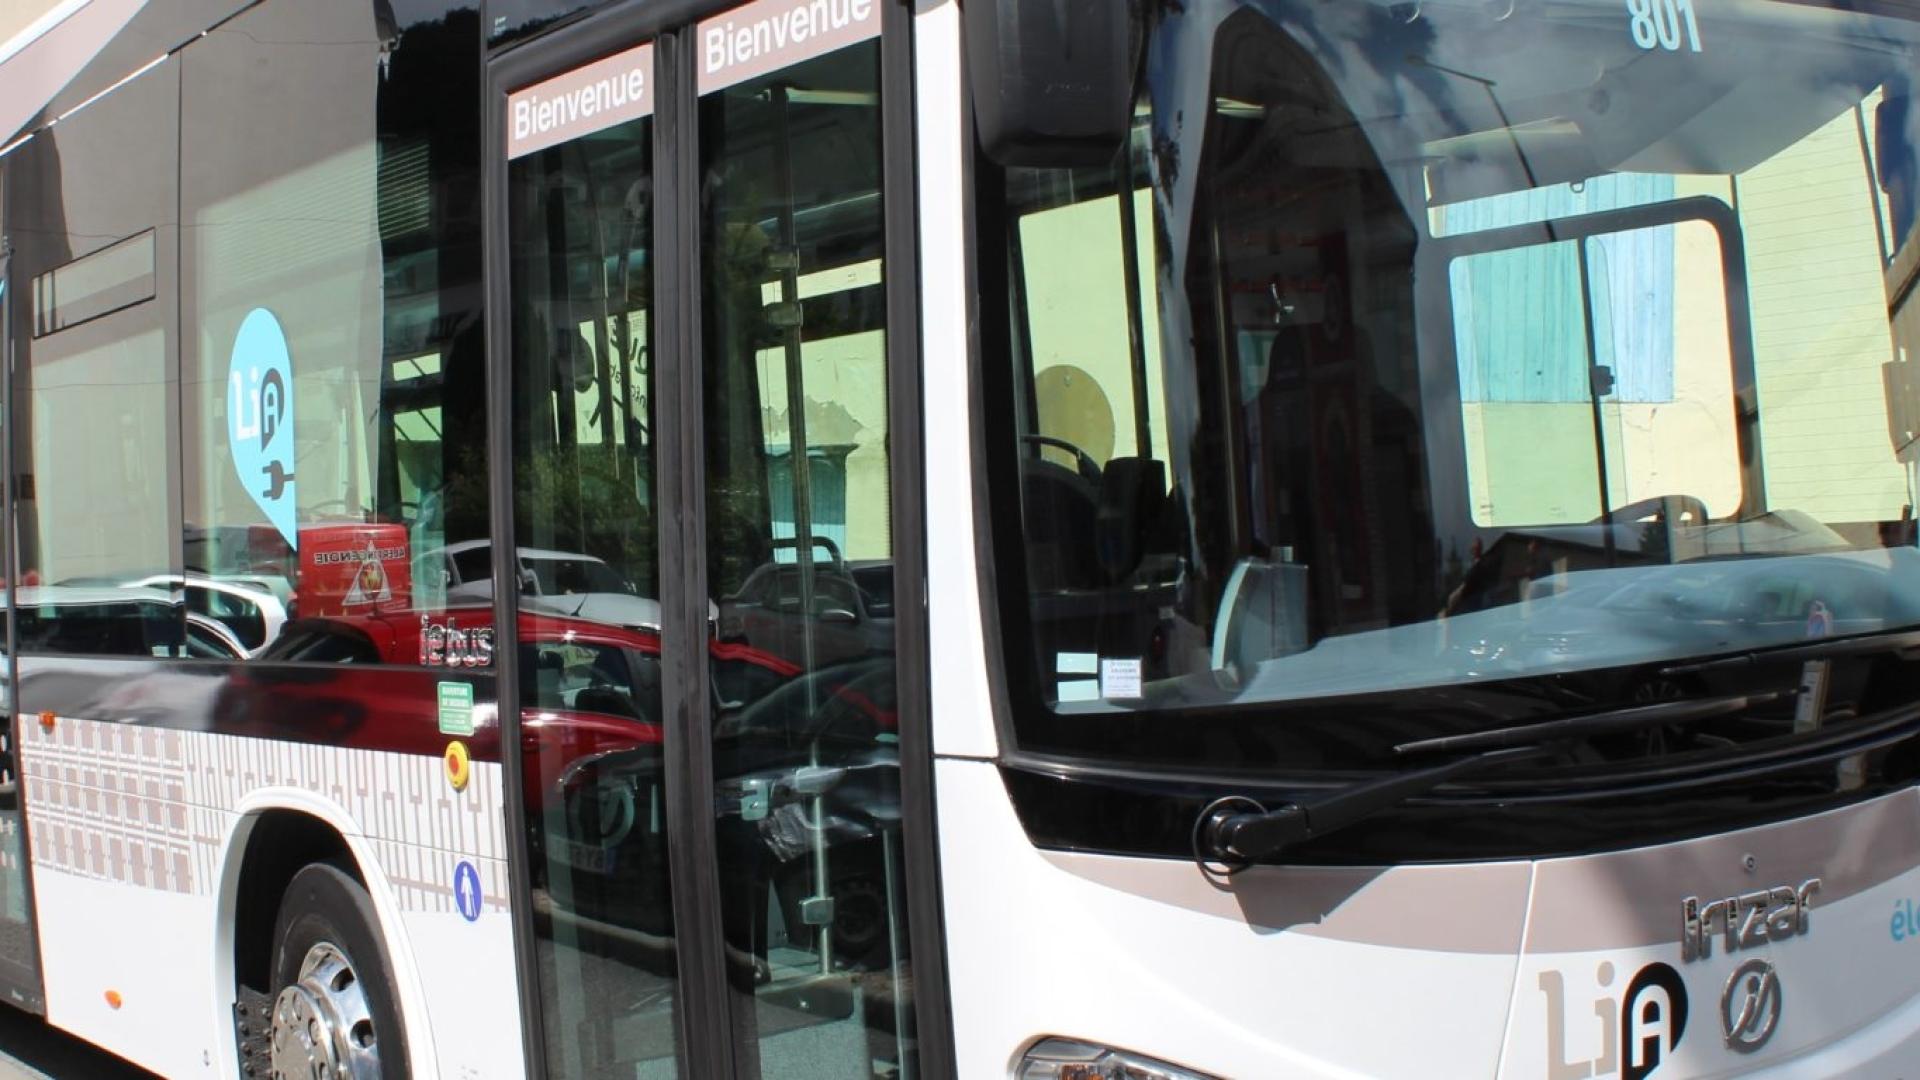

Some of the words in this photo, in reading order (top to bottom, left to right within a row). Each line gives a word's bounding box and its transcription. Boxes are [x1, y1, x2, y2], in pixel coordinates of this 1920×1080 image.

[706, 0, 872, 73] Bienvenue
[1626, 0, 1703, 52] 801
[514, 67, 643, 140] Bienvenue
[1890, 898, 1920, 942] él
